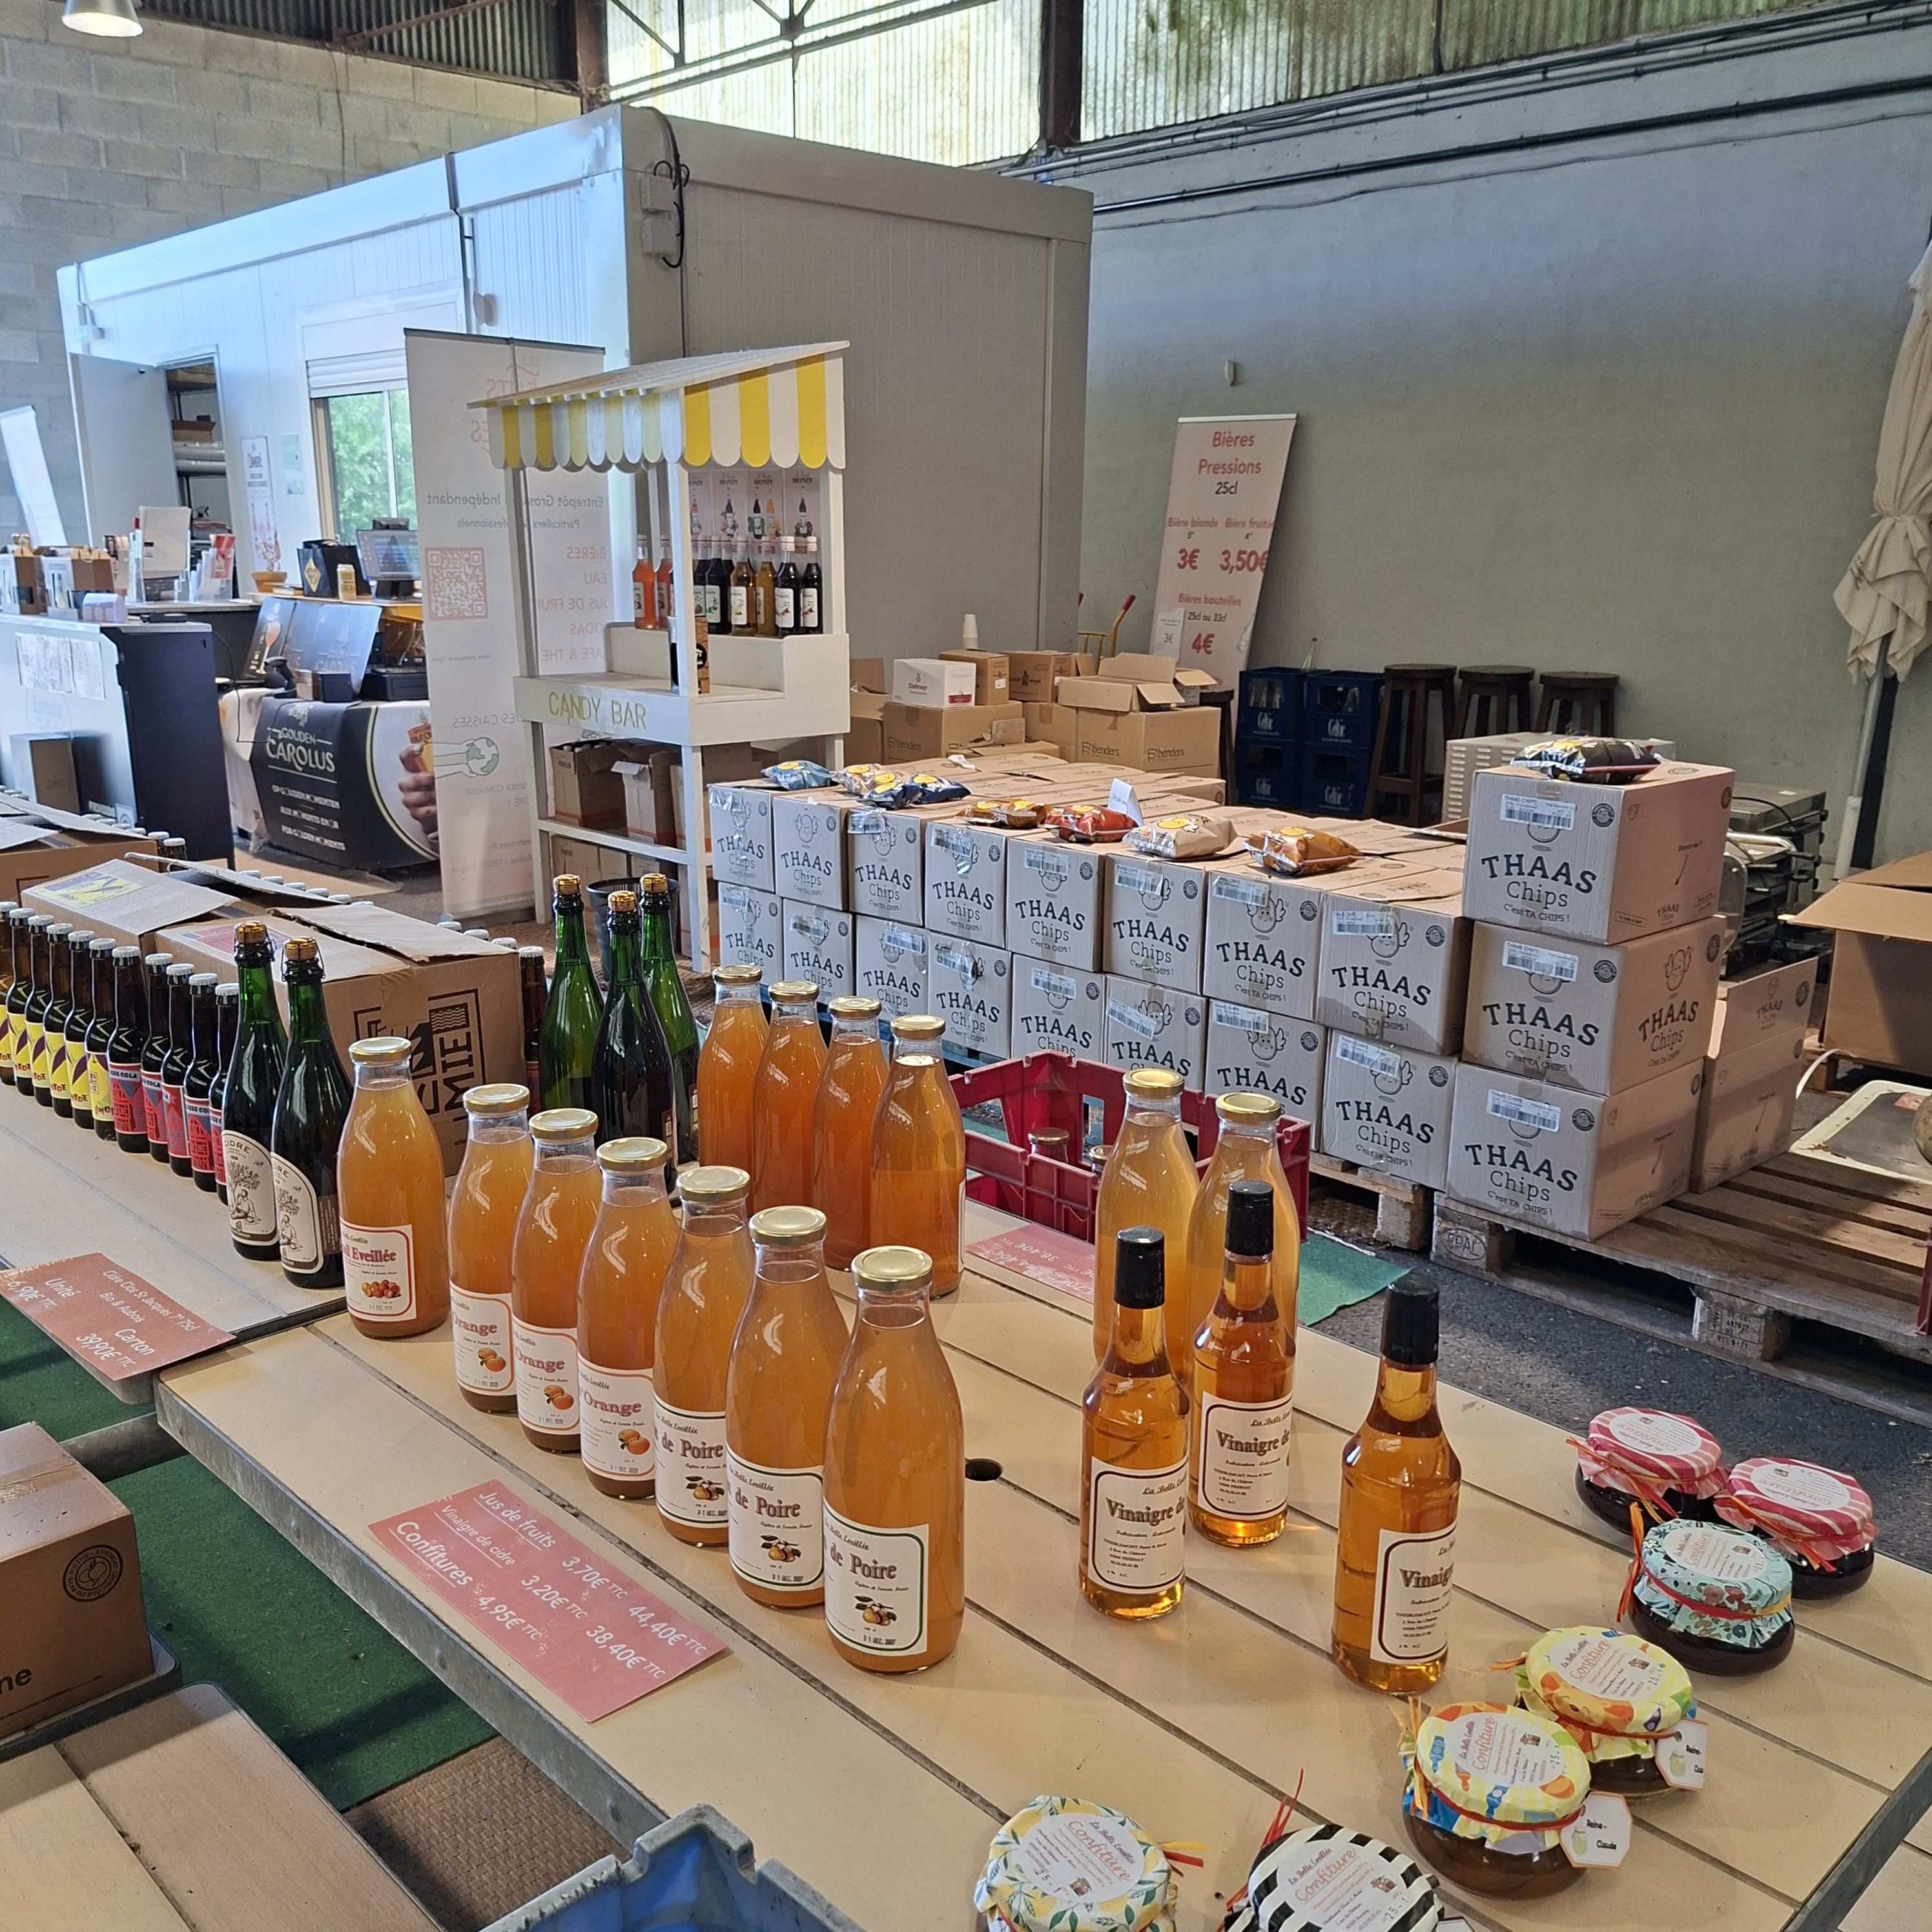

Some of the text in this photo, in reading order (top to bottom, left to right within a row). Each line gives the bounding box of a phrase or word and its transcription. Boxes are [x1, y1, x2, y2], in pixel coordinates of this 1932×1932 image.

[1213, 431, 1255, 447] Bières
[1198, 458, 1262, 475] Pressions
[1215, 481, 1238, 495] 25cl
[1177, 548, 1200, 570] 3€
[1220, 550, 1269, 574] 3,50€
[1192, 633, 1215, 655] 4€
[908, 683, 928, 691] Dallmayr
[549, 692, 646, 730] CANDY BAR
[280, 726, 316, 745] GOUDEN
[897, 738, 922, 752] benders
[266, 736, 336, 772] CAROLUS
[1092, 743, 1120, 757] benders
[1158, 747, 1185, 758] benders
[717, 836, 765, 859] THAAS
[781, 850, 832, 876] THAAS
[855, 864, 912, 890] THAAS
[1481, 853, 1597, 895] THAAS
[793, 868, 821, 887] Chips
[868, 883, 900, 902] Chips
[932, 881, 994, 910] THAAS
[1506, 881, 1568, 909] Chips
[947, 901, 980, 922] Chips
[1015, 899, 1086, 931] THAAS
[1504, 903, 1565, 922] C'est TA CHIPS
[725, 933, 775, 958] THAAS
[1031, 920, 1069, 943] Chips
[1113, 919, 1189, 952] THAAS
[737, 950, 764, 967] Chips
[791, 952, 845, 980] THAAS
[1131, 941, 1172, 965] Chips
[1217, 940, 1306, 978] THAAS
[803, 970, 833, 989] Chips
[863, 970, 921, 998] THAAS
[1237, 965, 1284, 990] Chips
[1331, 966, 1432, 1006] THAAS
[877, 988, 909, 1008] Chips
[936, 992, 1000, 1023] THAAS
[1354, 991, 1407, 1019] Chips
[951, 1011, 985, 1034] Chips
[1021, 1015, 1093, 1049] THAAS
[1483, 1002, 1600, 1047] THAAS
[1639, 1000, 1700, 1043] THAAS
[1509, 1029, 1570, 1058] Chips
[1650, 1027, 1683, 1053] Chips
[1112, 1041, 1191, 1077] THAAS
[1217, 1067, 1307, 1105] THAAS
[1336, 1100, 1435, 1144] THAAS
[224, 1140, 251, 1154] CIDRE
[1357, 1125, 1410, 1153] Chips
[1464, 1144, 1578, 1192] THAAS
[1490, 1169, 1550, 1202] Chips
[352, 1248, 396, 1262] Eveillée
[1014, 1242, 1060, 1262] 38,40€
[6, 1280, 57, 1309] 6,90€ TTC
[45, 1277, 81, 1298] Unité
[103, 1269, 120, 1288] Cidre
[120, 1281, 136, 1293] Clos
[134, 1290, 145, 1300] St
[143, 1293, 172, 1318] Jacques
[176, 1319, 200, 1331] 75cl
[99, 1291, 114, 1303] Bio
[119, 1306, 148, 1324] Aubois
[453, 1310, 497, 1336] Orange
[76, 1333, 136, 1368] 39,90€ TTC
[115, 1328, 155, 1356] Carton
[516, 1348, 565, 1373] Orange
[584, 1391, 642, 1417] Orange
[662, 1431, 723, 1459] de Poire
[1215, 1429, 1279, 1456] Vinaigre
[735, 1487, 801, 1518] de Poire
[1142, 1486, 1155, 1495] La
[479, 1492, 555, 1548] Jus de fruits
[1105, 1497, 1174, 1526] Vinaigre
[442, 1505, 515, 1566] Vinaigre de cidre
[396, 1521, 473, 1587] Confitures
[830, 1542, 897, 1579] de Poire
[562, 1556, 628, 1599] 3,70€ TTC
[1399, 1563, 1454, 1588] Vinaig
[522, 1575, 588, 1619] 3,20€ TTC
[479, 1596, 543, 1640] 4,95€ TTC
[629, 1606, 707, 1655] 44,40€ TTC
[586, 1625, 666, 1679] 38,40€ TTC
[1570, 1639, 1610, 1680] Confiture
[1472, 1716, 1496, 1771] Confiture
[1067, 1820, 1133, 1882] Confiture
[1295, 1847, 1357, 1902] Confiture
